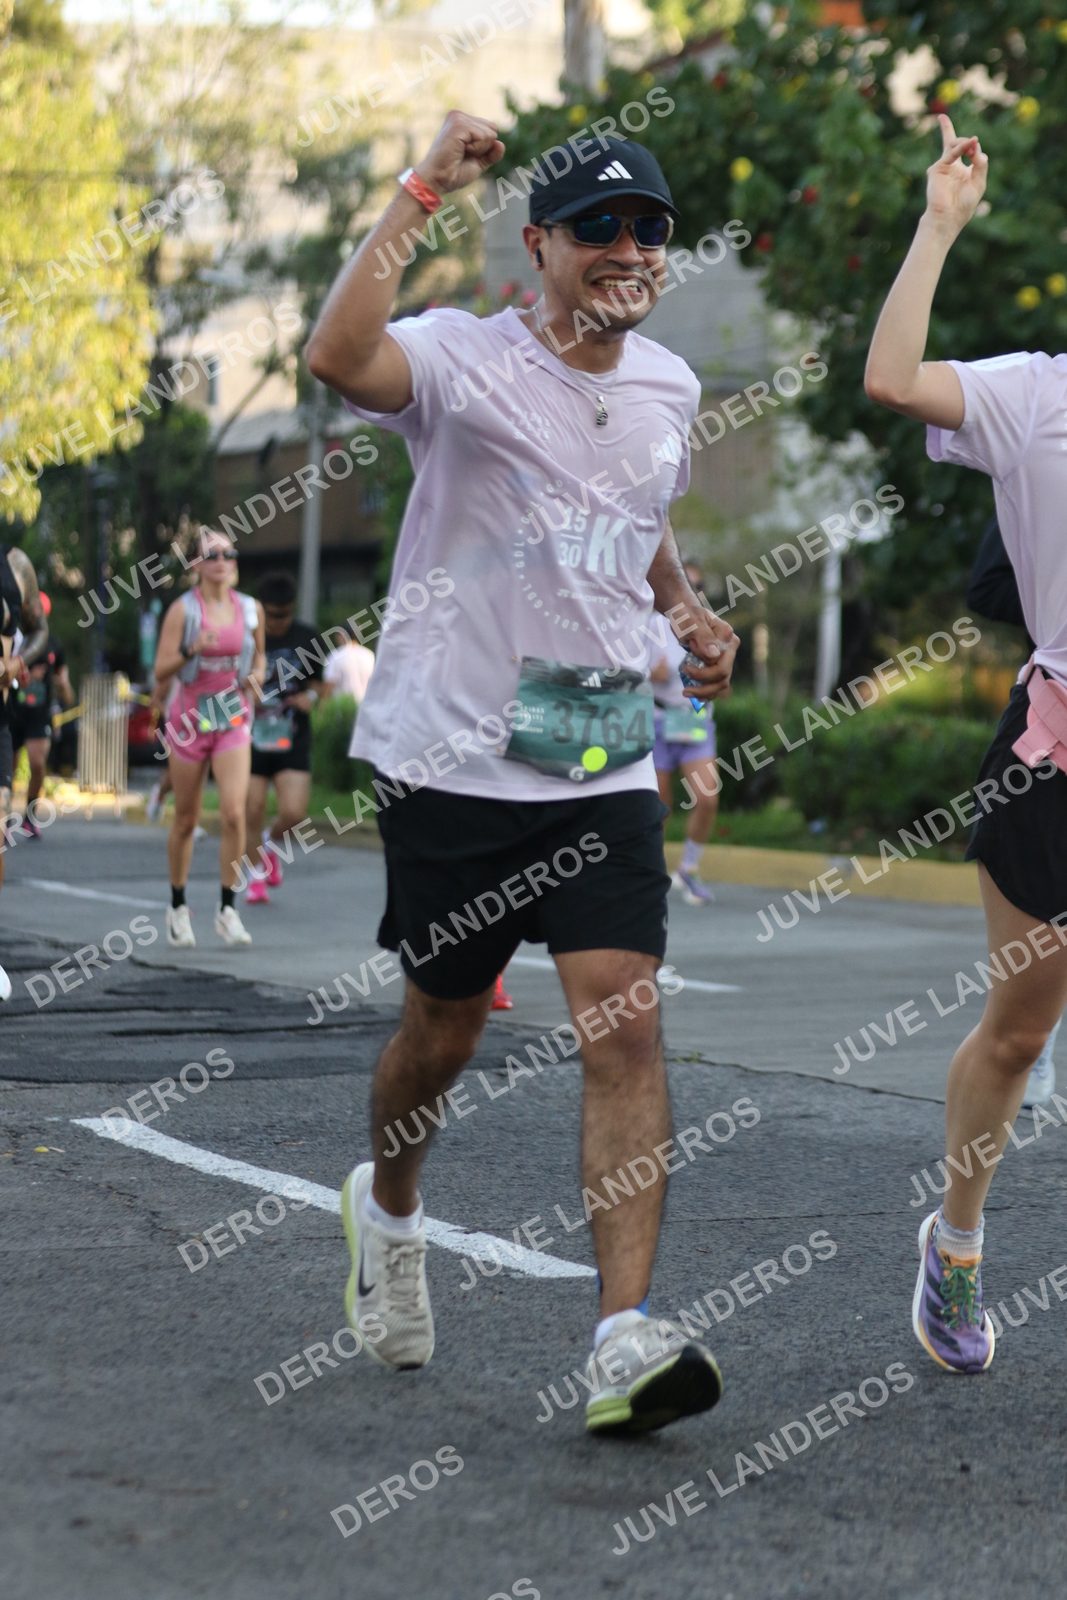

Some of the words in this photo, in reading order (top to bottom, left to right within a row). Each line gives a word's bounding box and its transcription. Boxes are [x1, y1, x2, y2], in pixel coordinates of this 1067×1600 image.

[558, 541, 583, 569] 30
[586, 513, 629, 577] K
[551, 700, 650, 752] 3764
